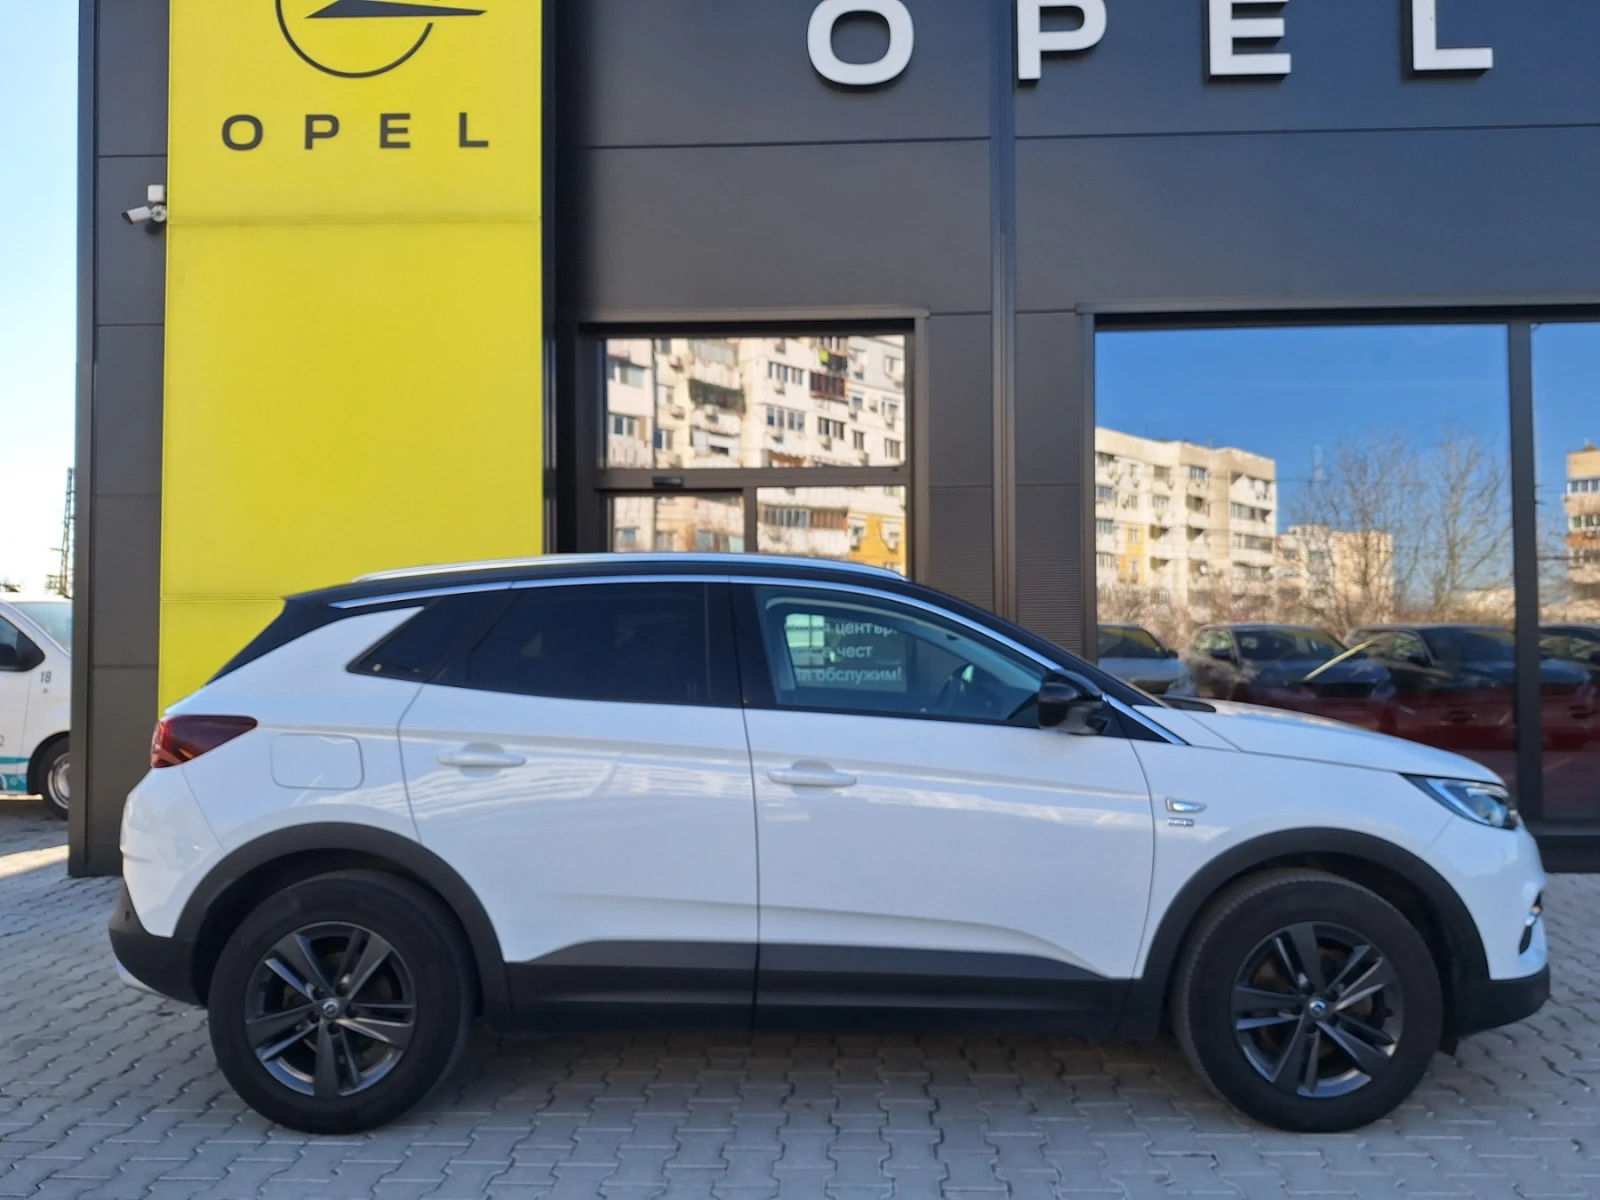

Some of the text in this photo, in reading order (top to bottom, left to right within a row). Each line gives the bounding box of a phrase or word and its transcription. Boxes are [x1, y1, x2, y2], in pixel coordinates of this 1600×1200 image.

[807, 0, 1493, 86] OPEL
[222, 112, 489, 150] OPEL
[836, 645, 873, 658] чест
[40, 671, 52, 684] 18
[816, 666, 902, 685] обслужим!
